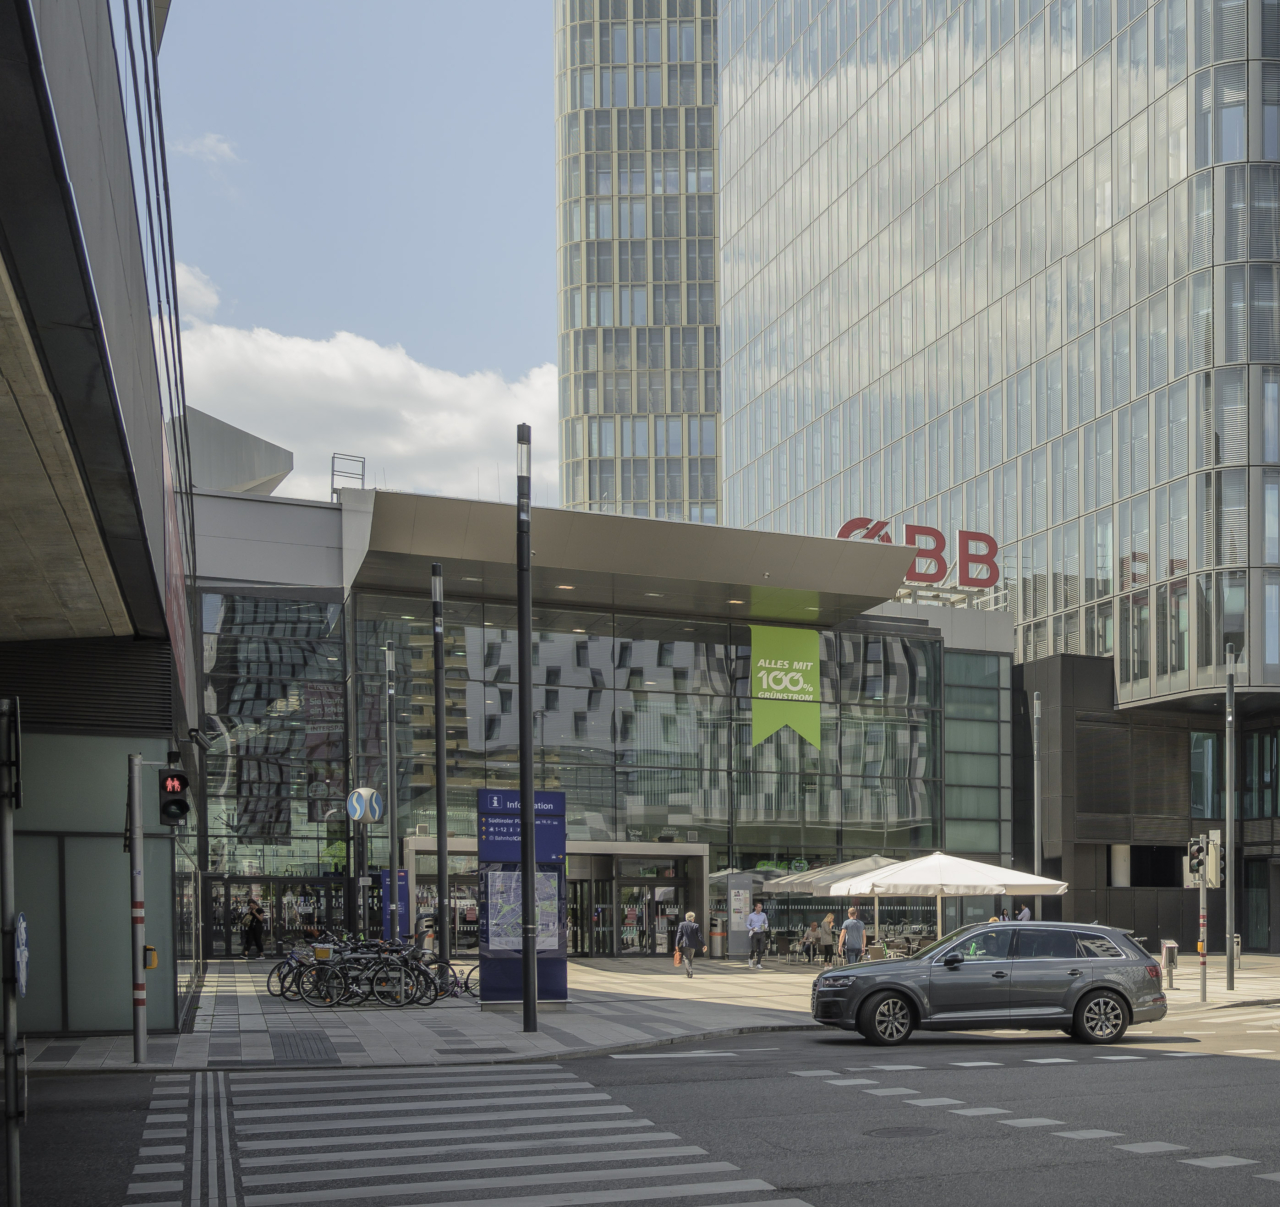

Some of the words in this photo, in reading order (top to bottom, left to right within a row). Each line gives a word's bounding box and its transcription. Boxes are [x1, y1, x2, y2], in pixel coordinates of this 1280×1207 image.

[757, 658, 789, 669] ALLES
[792, 661, 814, 671] MIT
[757, 670, 814, 692] 100%
[757, 691, 814, 701] GRÜNSTROM
[310, 724, 344, 732] INTERSPA
